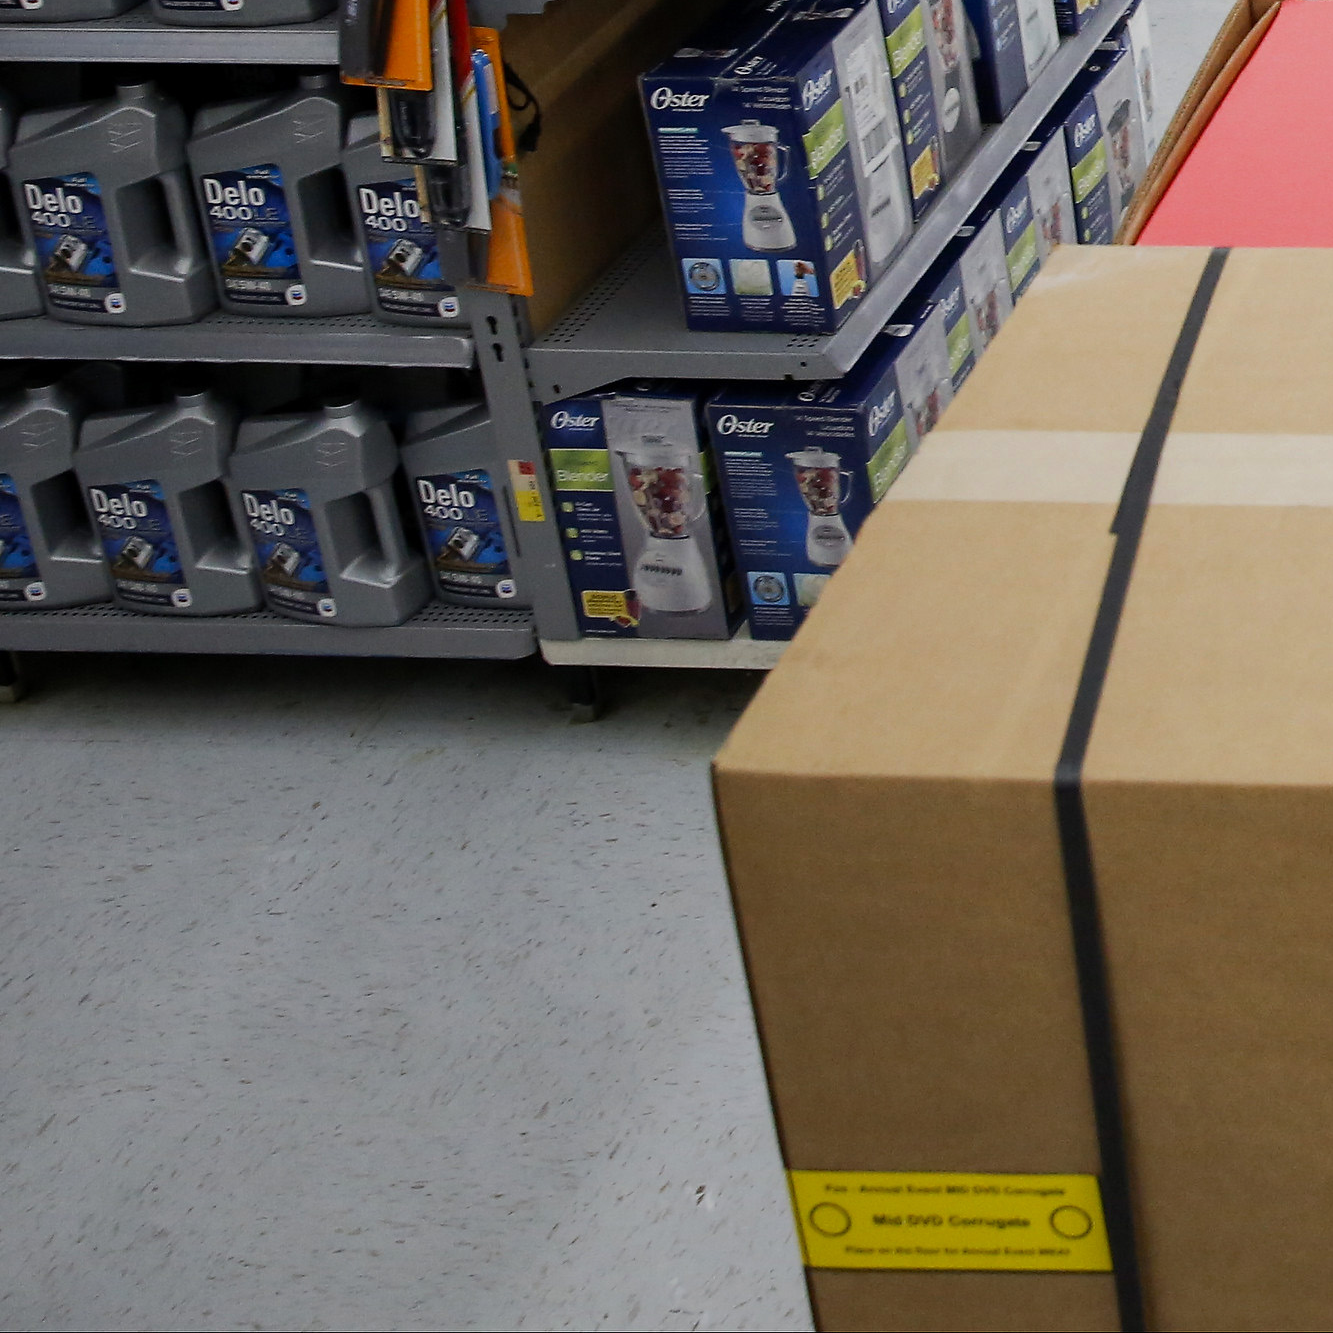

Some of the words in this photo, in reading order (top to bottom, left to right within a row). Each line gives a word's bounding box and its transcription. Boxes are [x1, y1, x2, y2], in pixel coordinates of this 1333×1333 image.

[650, 85, 711, 111] Oster
[801, 67, 834, 112] Oster
[1074, 117, 1098, 149] Oster
[24, 184, 83, 214] Delo
[203, 178, 266, 207] Delo
[358, 187, 421, 217] Delo
[31, 211, 71, 228] 400
[209, 204, 253, 221] 400
[364, 214, 408, 232] 400
[550, 409, 601, 431] Oster
[716, 412, 775, 437] Oster
[556, 469, 609, 484] Blender
[90, 487, 149, 519] Delo
[417, 479, 477, 509] Delo
[96, 512, 138, 531] 400
[242, 492, 296, 527] Delo
[423, 504, 464, 522] 400
[948, 1214, 1031, 1229] Corrugate
